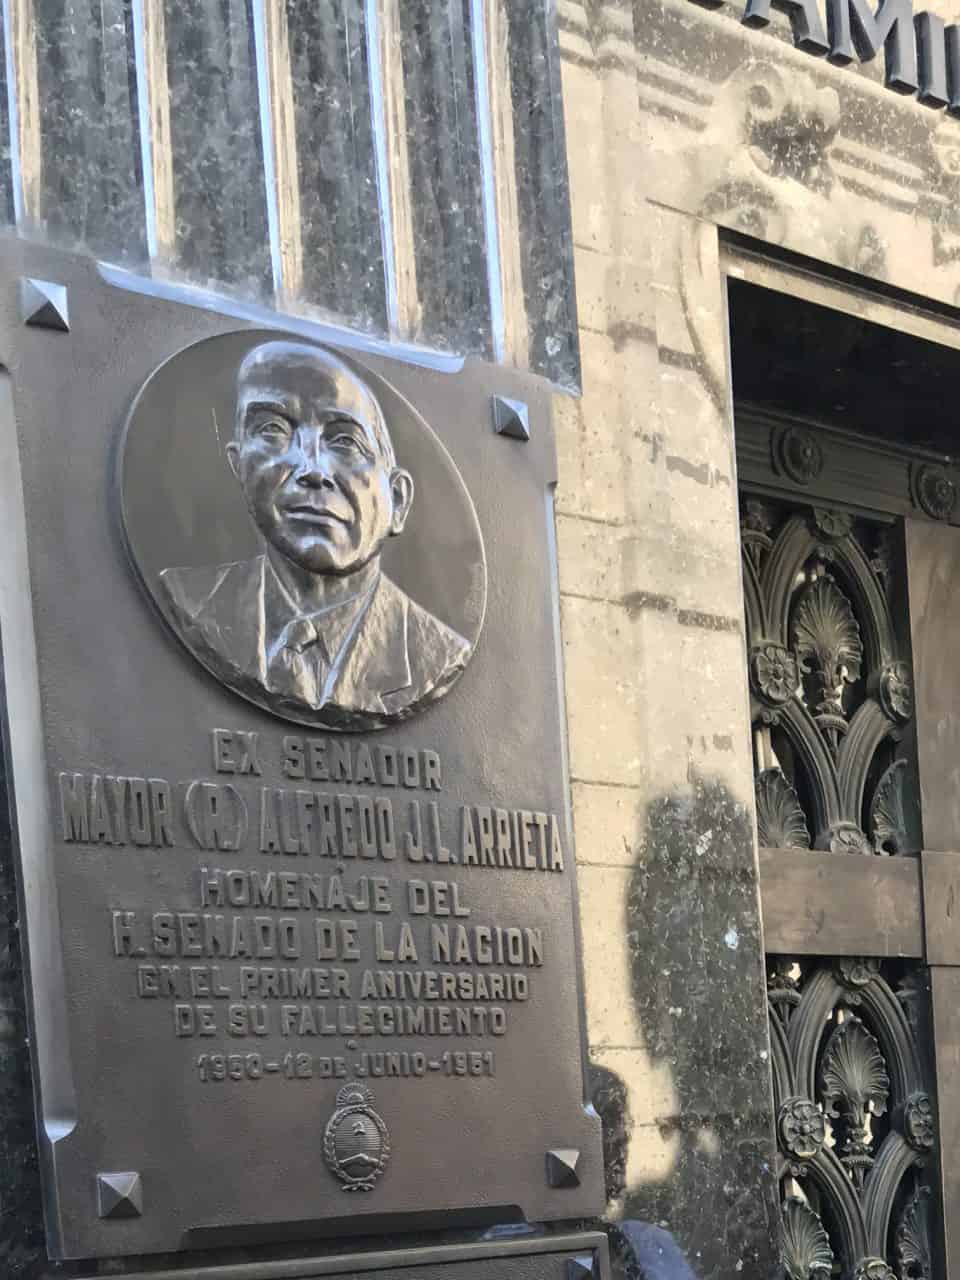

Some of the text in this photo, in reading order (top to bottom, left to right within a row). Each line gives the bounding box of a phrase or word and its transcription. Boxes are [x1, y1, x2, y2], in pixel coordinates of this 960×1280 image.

[211, 728, 443, 792] EX SENADOR
[58, 771, 175, 847] MAYOR
[260, 787, 394, 860] ALFREDO
[460, 804, 565, 872] ARRIETA
[200, 867, 471, 917] HOMENAJE DEL
[315, 918, 361, 961] DE
[375, 922, 418, 963] LA
[431, 924, 544, 967] NACION
[137, 965, 528, 1002] EN EL PRIMER ANIVERSARIO
[173, 1004, 507, 1038] DE SU FALLECIMIENTO
[319, 1056, 346, 1078] DE
